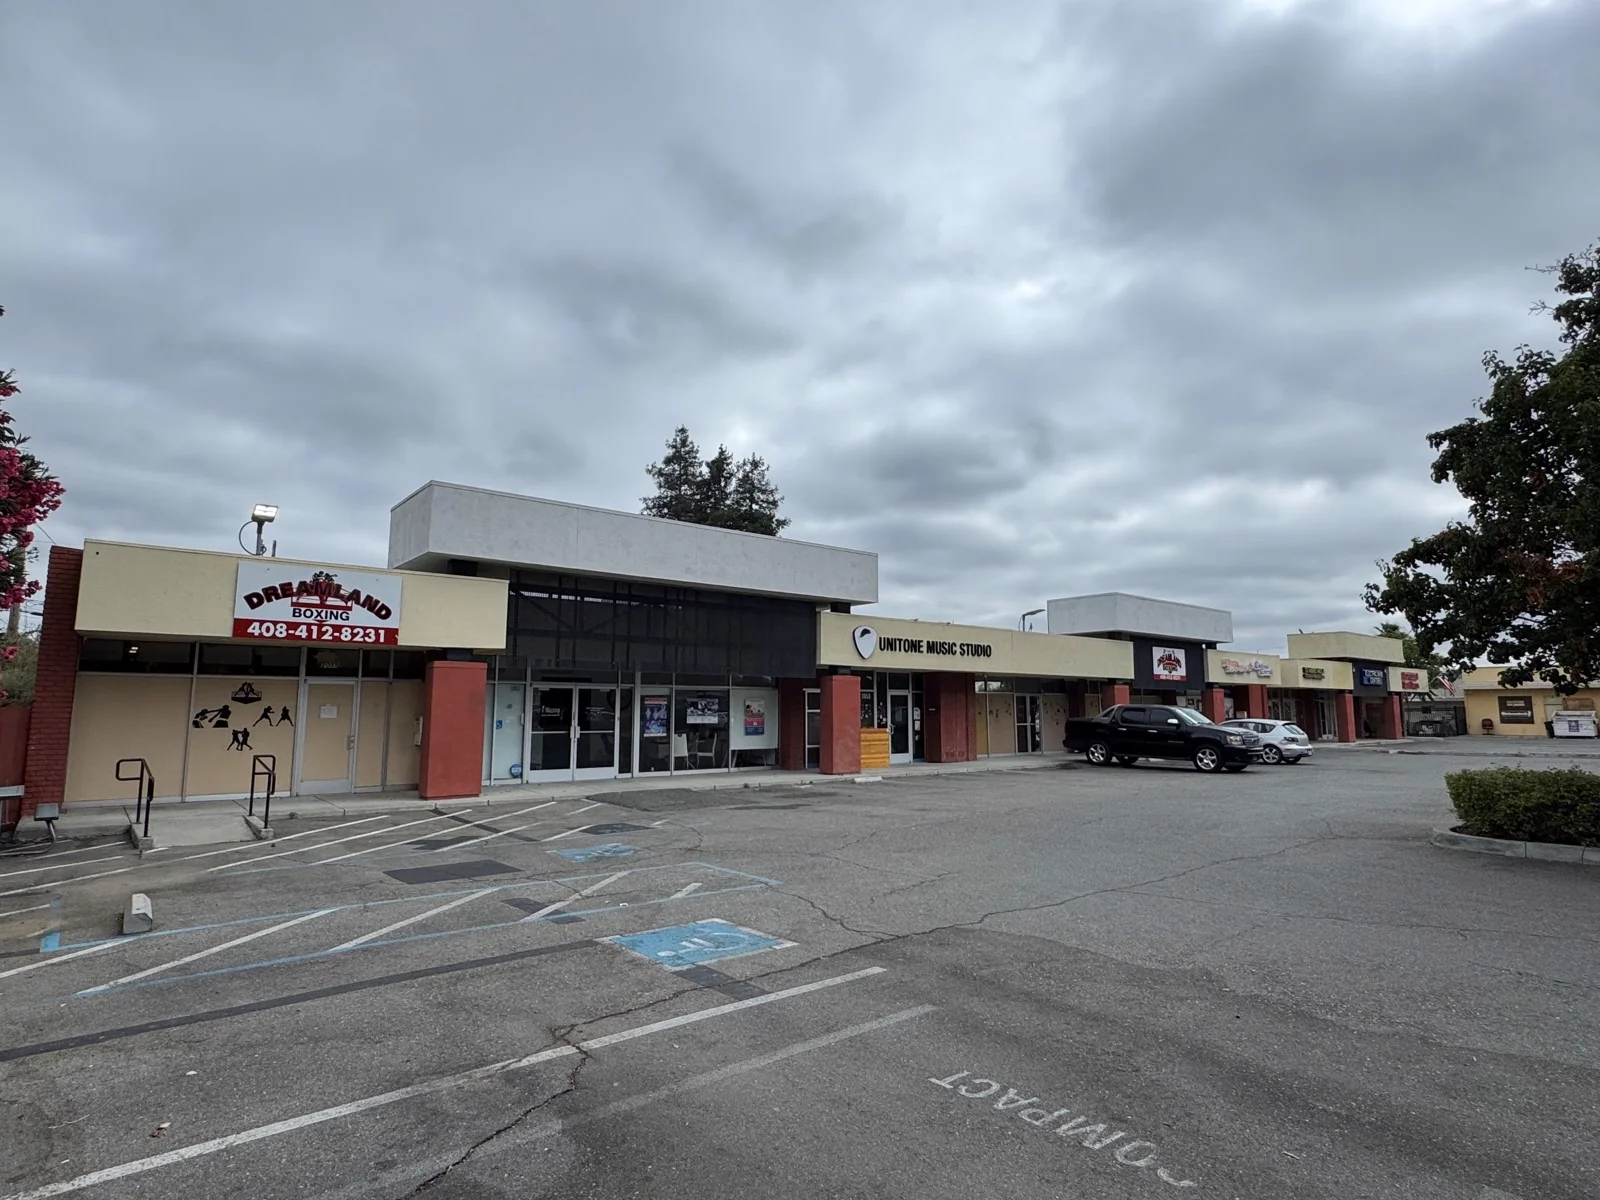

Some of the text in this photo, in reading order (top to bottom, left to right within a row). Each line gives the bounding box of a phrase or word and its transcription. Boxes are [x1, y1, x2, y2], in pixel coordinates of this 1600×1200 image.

[243, 580, 392, 621] DREAMLAND
[292, 608, 350, 621] BOXING
[247, 622, 386, 643] 408-412-8231
[879, 636, 992, 658] UNITONE MUSIC STUDIO
